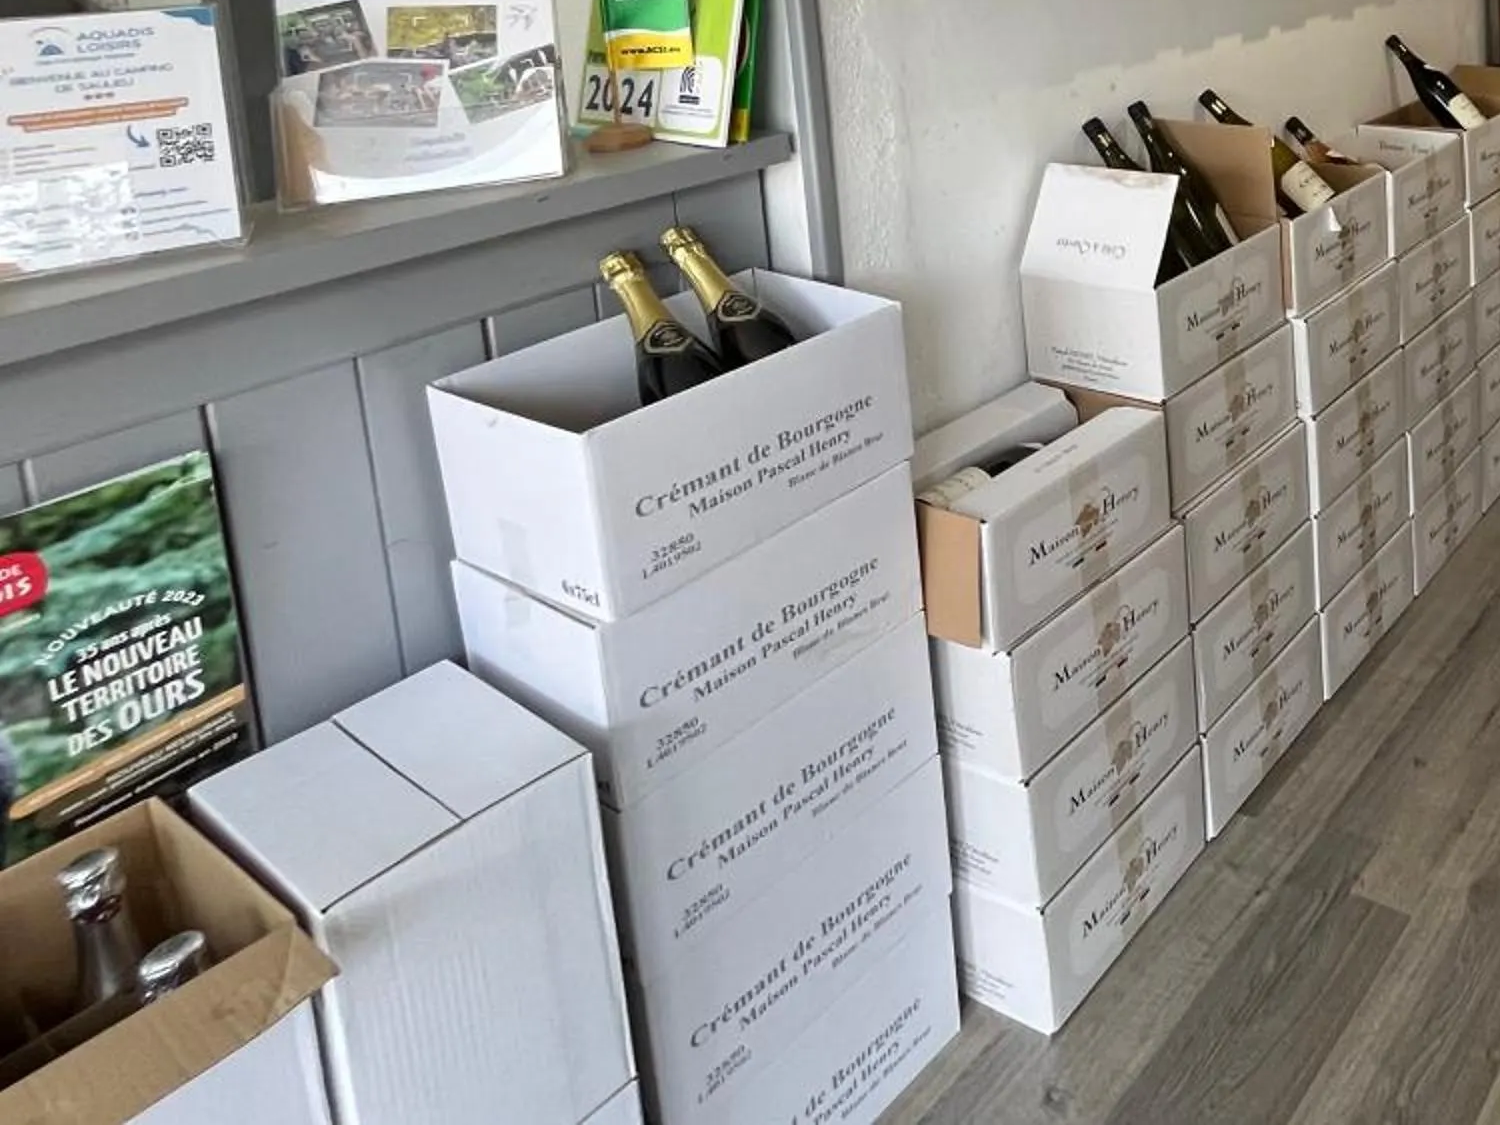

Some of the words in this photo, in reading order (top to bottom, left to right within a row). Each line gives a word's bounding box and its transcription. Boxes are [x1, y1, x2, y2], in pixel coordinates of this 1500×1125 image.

[634, 456, 741, 518] Crémant
[747, 441, 772, 465] de
[777, 394, 874, 450] Bourgogne
[687, 477, 754, 519] Maison
[757, 442, 806, 485] Pascal
[808, 429, 852, 457] Henry
[1028, 525, 1080, 566] Maison
[1100, 486, 1139, 516] Henry
[32, 590, 158, 667] NOUVEAUTÉ
[48, 670, 79, 701] LE
[81, 616, 204, 686] NOUVEAU
[638, 635, 745, 709] Crémant
[751, 619, 776, 643] de
[780, 557, 879, 625] Bourgogne
[692, 654, 758, 703] Maison
[761, 619, 809, 659] Pascal
[812, 594, 857, 627] Henry
[1053, 647, 1102, 692] Maison
[1117, 598, 1159, 633] Henry
[61, 644, 201, 723] TERRITOIRE
[67, 718, 113, 757] DES
[119, 668, 206, 732] OURS
[666, 800, 767, 881] Crémant
[772, 781, 796, 806] de
[800, 707, 895, 784] Bourgogne
[716, 818, 779, 870] Maison
[782, 777, 830, 820] Pascal
[833, 746, 874, 784] Henry
[1069, 766, 1115, 816] Maison
[1134, 712, 1169, 748] Henry
[1082, 886, 1126, 939] Maison
[1143, 824, 1178, 864] Henry
[690, 958, 787, 1048] Crémant
[793, 935, 815, 962] de
[820, 853, 912, 937] Bourgogne
[738, 975, 799, 1032] Maison
[803, 928, 848, 975] Pascal
[850, 894, 892, 933] Henry
[804, 1089, 826, 1118] de
[831, 997, 922, 1091] Bourgogne
[814, 1077, 858, 1125] Pascal
[861, 1040, 900, 1082] Henry
